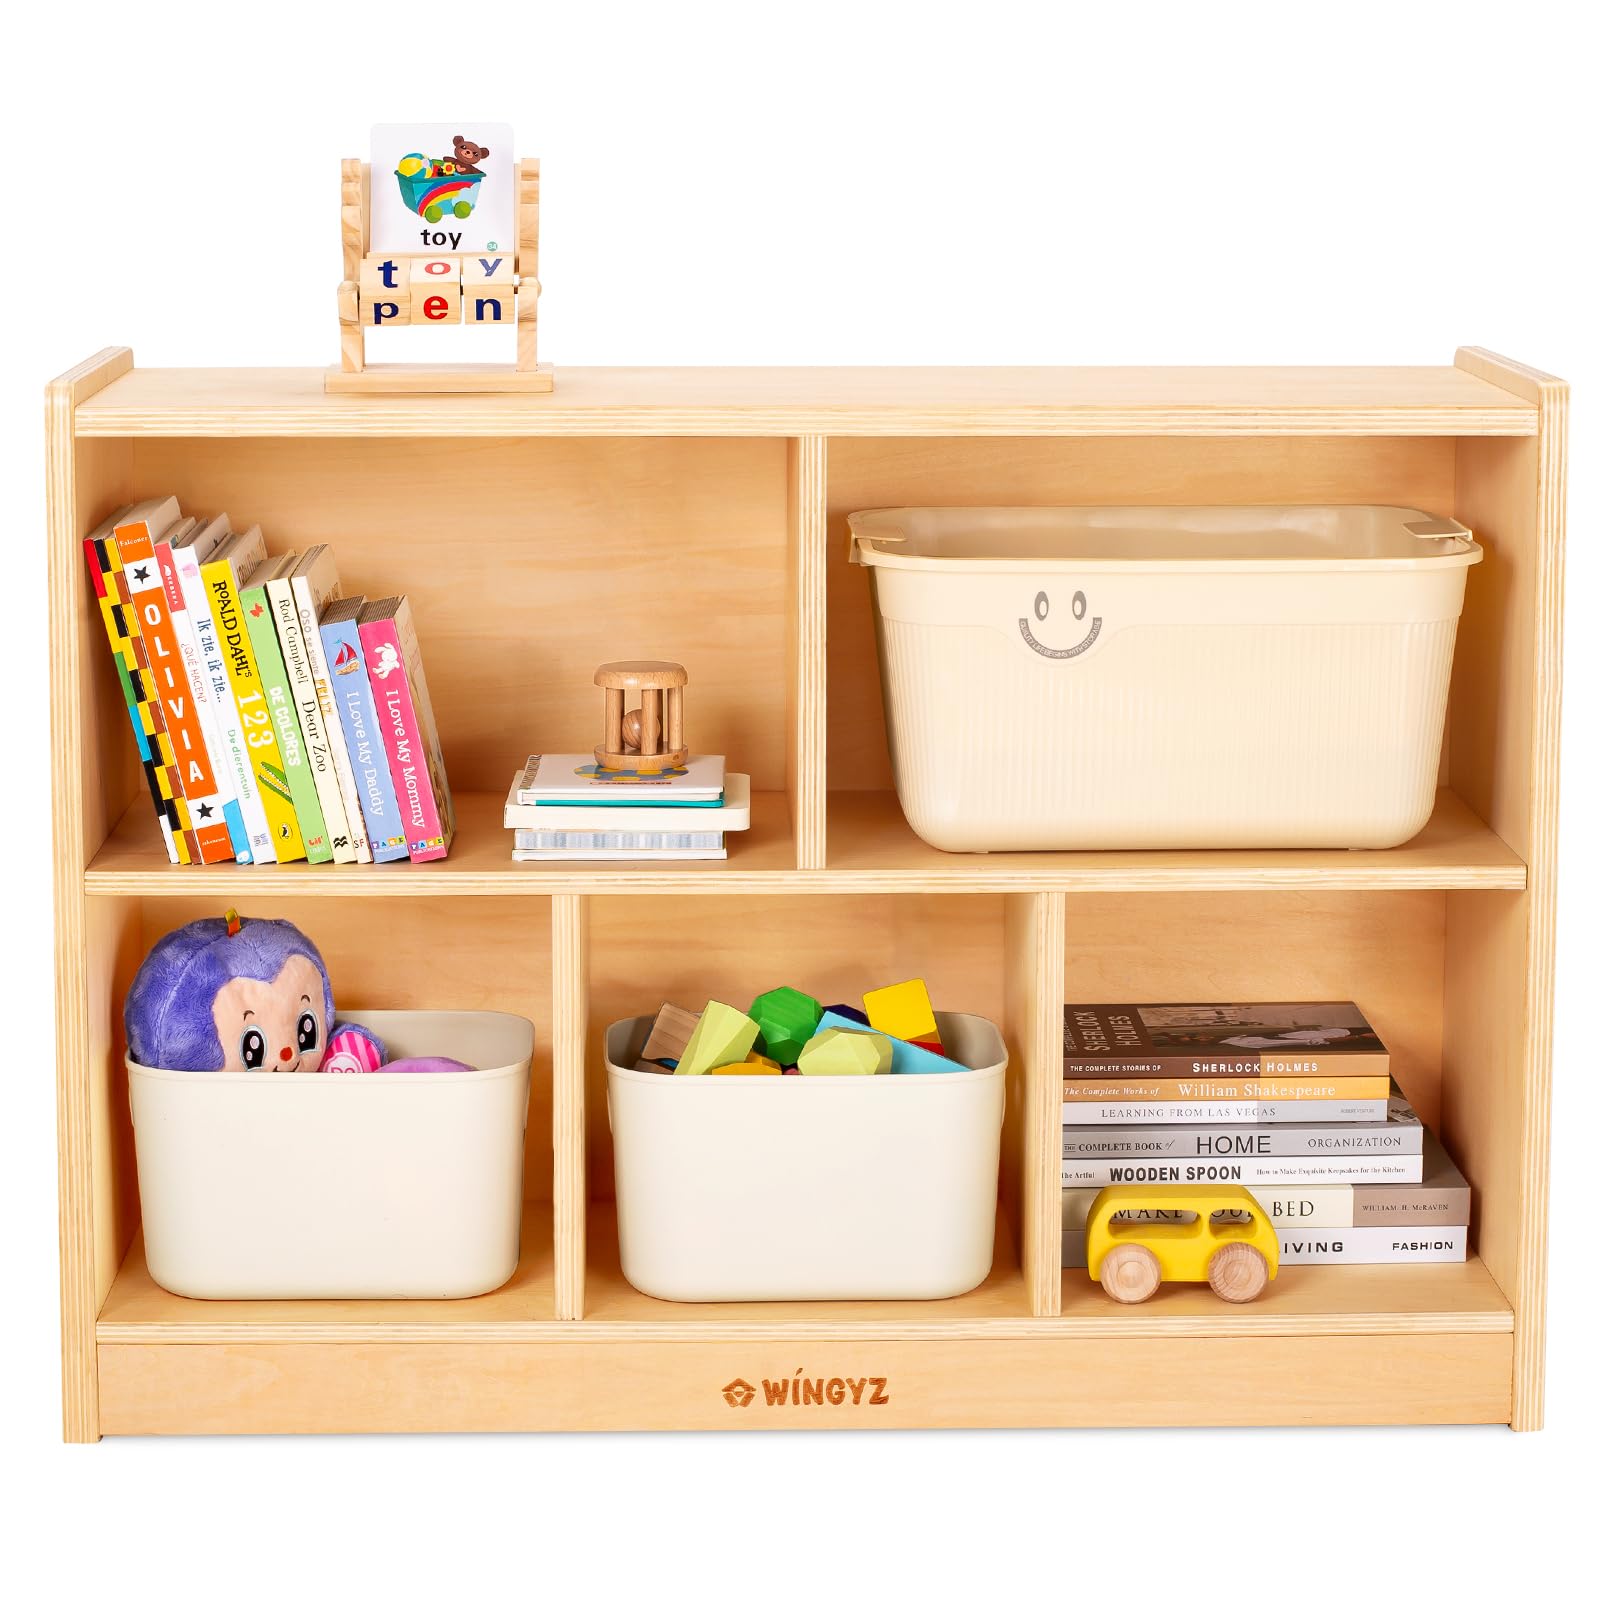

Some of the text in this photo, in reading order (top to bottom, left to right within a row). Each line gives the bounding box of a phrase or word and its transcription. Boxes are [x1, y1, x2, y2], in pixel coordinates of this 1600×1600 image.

[421, 229, 462, 250] toy
[213, 580, 238, 631] ROALD
[279, 599, 309, 683] Rod Campbell
[145, 605, 204, 783] OLIVIA
[269, 686, 301, 767] DE COLORES
[301, 699, 327, 772] Dear Zoo
[227, 729, 250, 799] De dierentuin
[347, 691, 384, 817] I Love My Daddy
[386, 689, 425, 828] I Love My Mommy
[1073, 1011, 1110, 1051] SHERLOCK
[1108, 1015, 1142, 1046] HOLMES
[1192, 1062, 1261, 1073] SHERLOCK
[1266, 1062, 1319, 1072] HOLMES
[1082, 1087, 1120, 1097] Complete
[1122, 1087, 1148, 1095] Works
[1150, 1087, 1160, 1097] of
[1178, 1083, 1238, 1097] William
[1244, 1083, 1336, 1099] Shakespeare
[1101, 1107, 1277, 1118] LEARNING FROM LAS VEGAS
[1078, 1143, 1132, 1152] COMPLETE
[1135, 1142, 1163, 1150] BOOK
[1197, 1136, 1271, 1154] HOME
[1307, 1136, 1401, 1148] ORGANIZATION
[1109, 1167, 1180, 1182] WOODEN
[1186, 1166, 1241, 1180] SPOON
[1328, 1167, 1359, 1175] Keepsakes
[1272, 1201, 1314, 1217] BED
[1284, 1241, 1453, 1254] IVING FASHION
